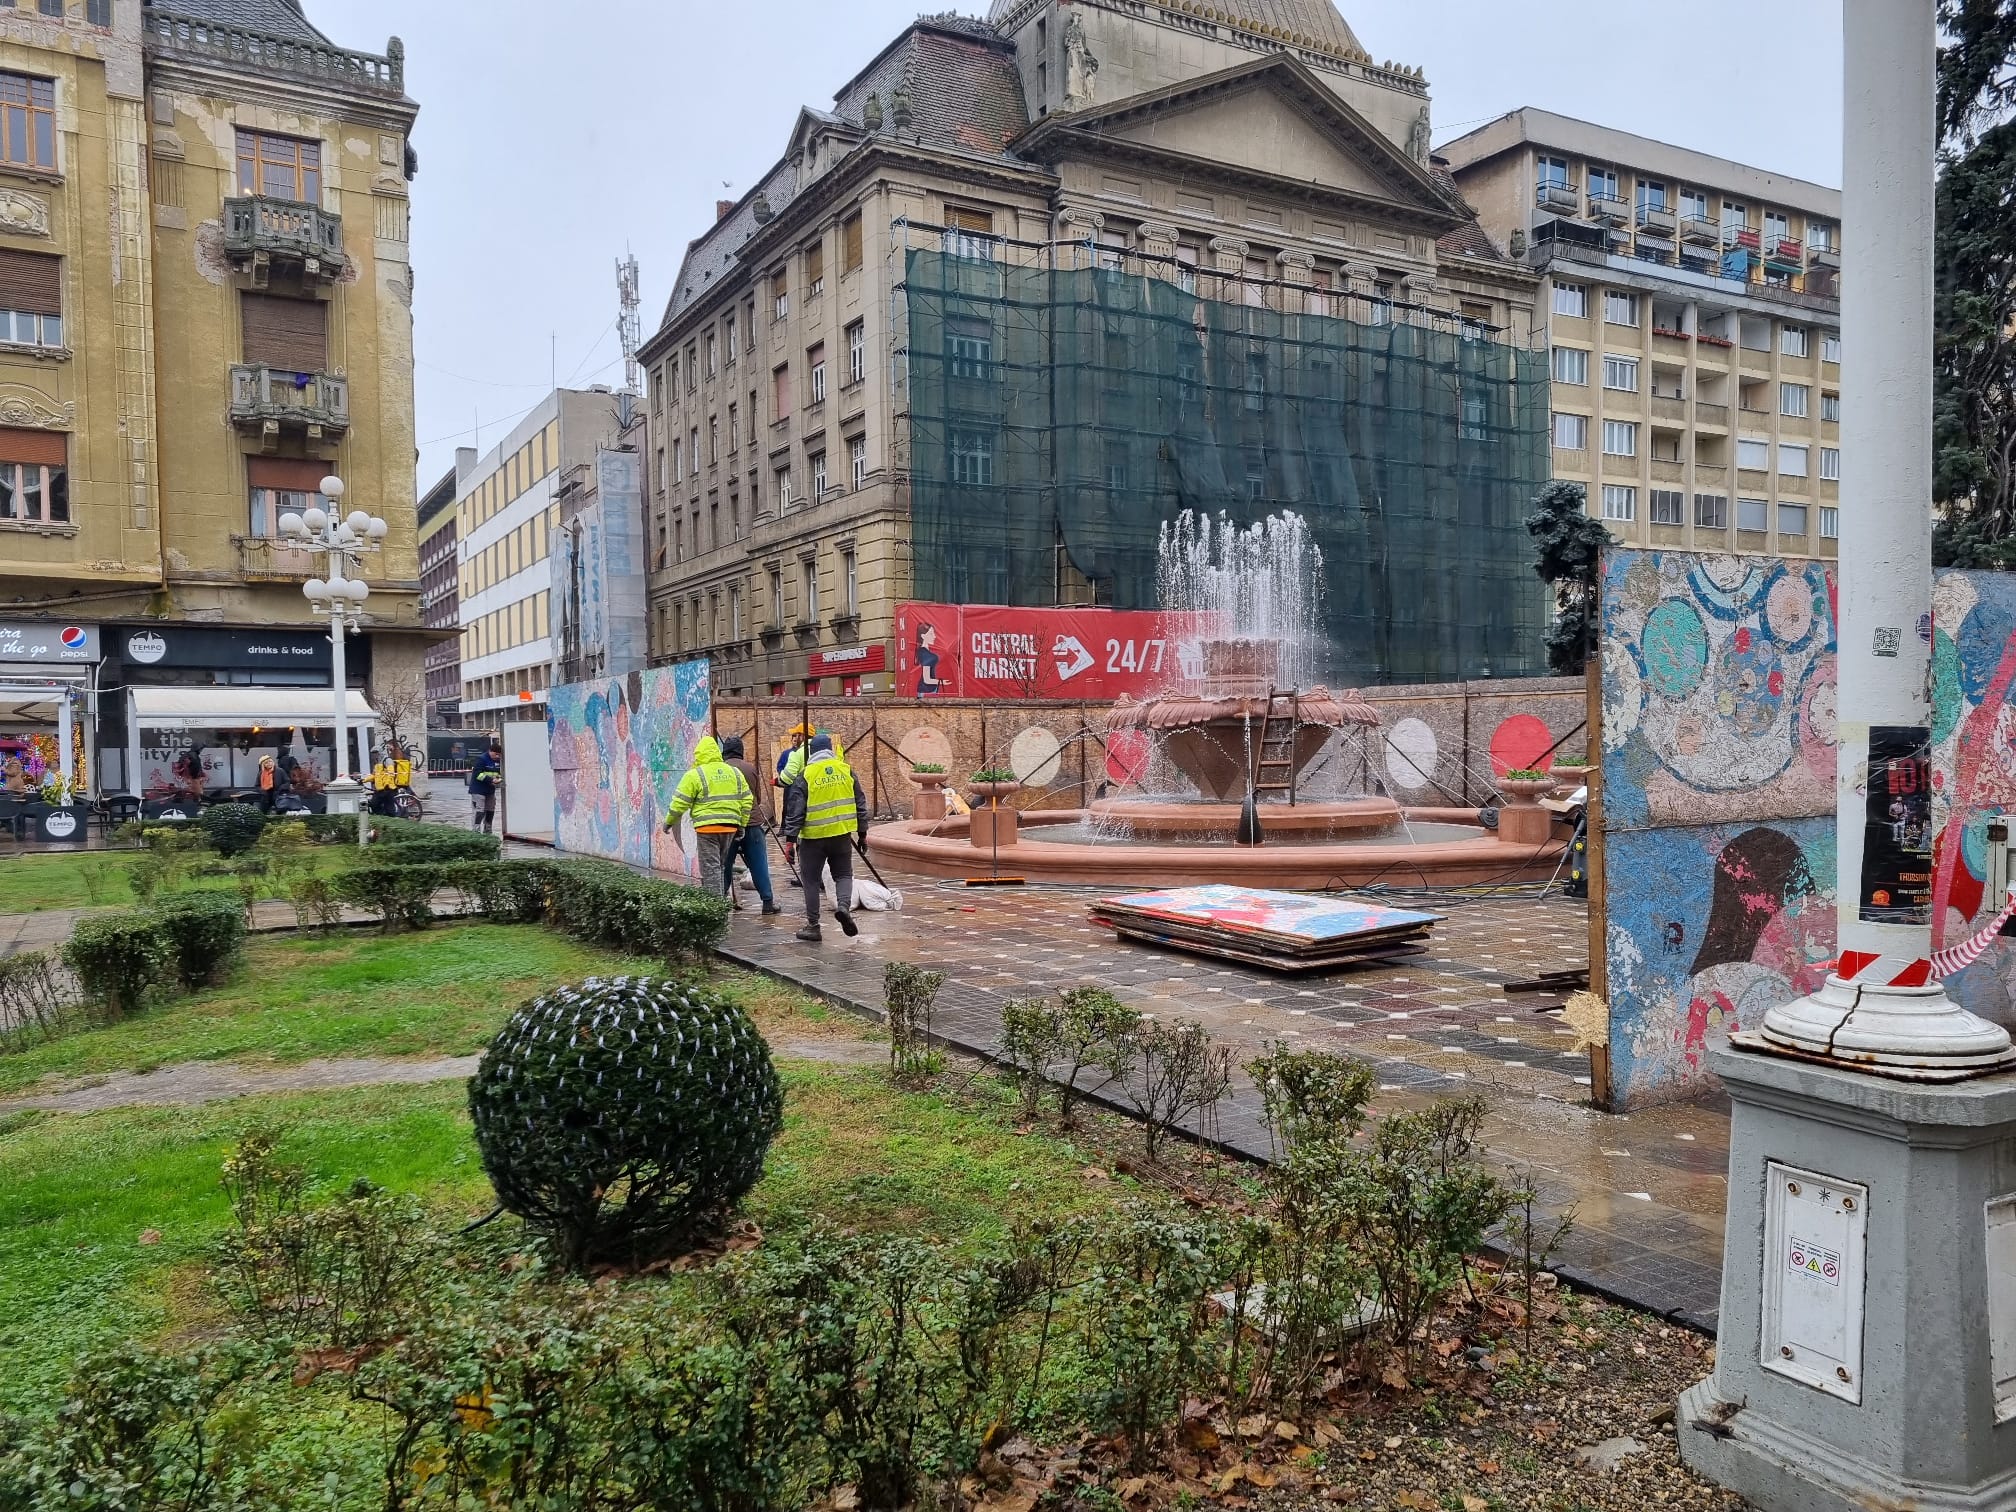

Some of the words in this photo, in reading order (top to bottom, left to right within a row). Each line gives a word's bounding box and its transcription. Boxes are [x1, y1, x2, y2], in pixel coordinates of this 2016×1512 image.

[3, 640, 24, 654] the
[30, 645, 47, 658] go
[247, 645, 279, 655] drinks
[281, 646, 289, 654] &
[291, 646, 313, 655] food
[972, 632, 1038, 655] CENTRAL
[60, 650, 88, 658] pepsi
[1106, 638, 1166, 673] 24/7
[974, 657, 1036, 679] MARKET
[160, 734, 192, 747] the
